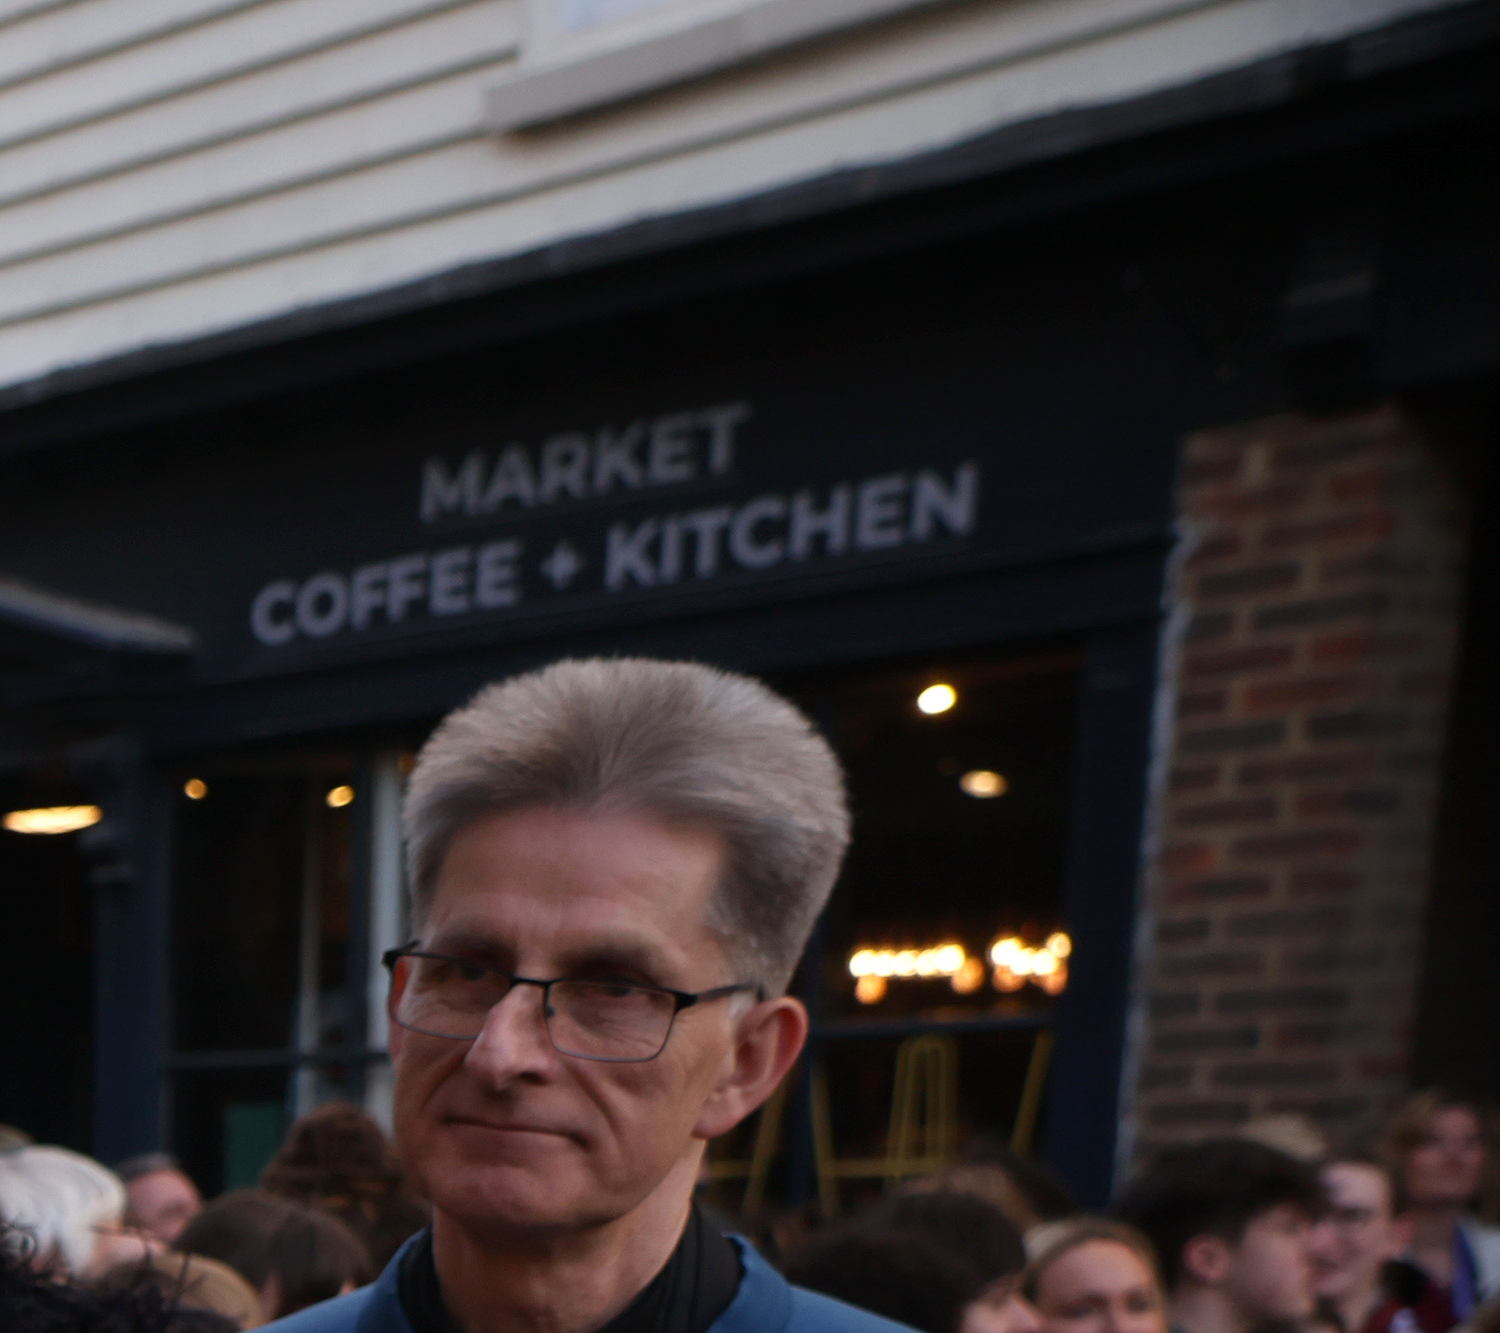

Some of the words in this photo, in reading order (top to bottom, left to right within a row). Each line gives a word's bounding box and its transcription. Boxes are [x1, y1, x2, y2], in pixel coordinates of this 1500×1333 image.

[421, 403, 750, 522] MARKET
[251, 538, 522, 646] COFFEE
[605, 460, 980, 590] KITCHEN
